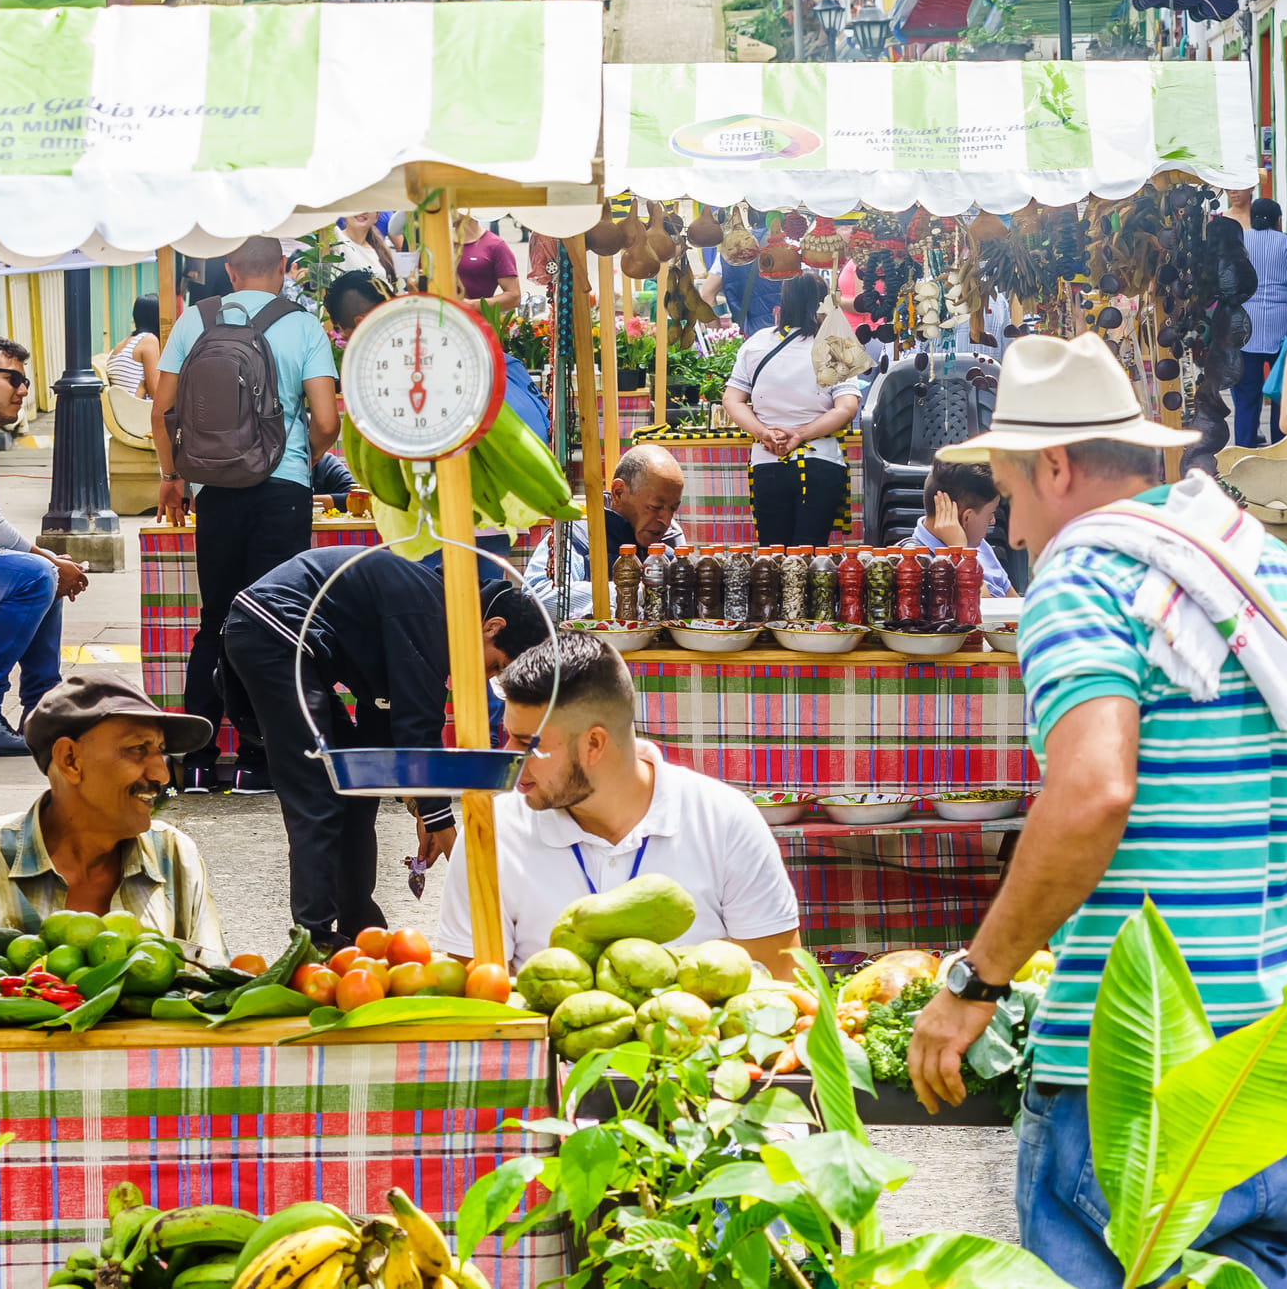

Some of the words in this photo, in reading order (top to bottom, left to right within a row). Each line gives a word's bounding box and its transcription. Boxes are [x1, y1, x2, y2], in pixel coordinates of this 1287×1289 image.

[719, 130, 775, 141] CREER
[934, 134, 1008, 144] MUNICIPAL
[391, 338, 403, 348] 18
[442, 337, 448, 346] 2
[376, 360, 388, 370] 16
[456, 360, 462, 369] 4
[378, 386, 389, 397] 14
[456, 385, 462, 395] 6
[393, 407, 405, 417] 12
[441, 408, 447, 417] 8
[415, 418, 427, 428] 10
